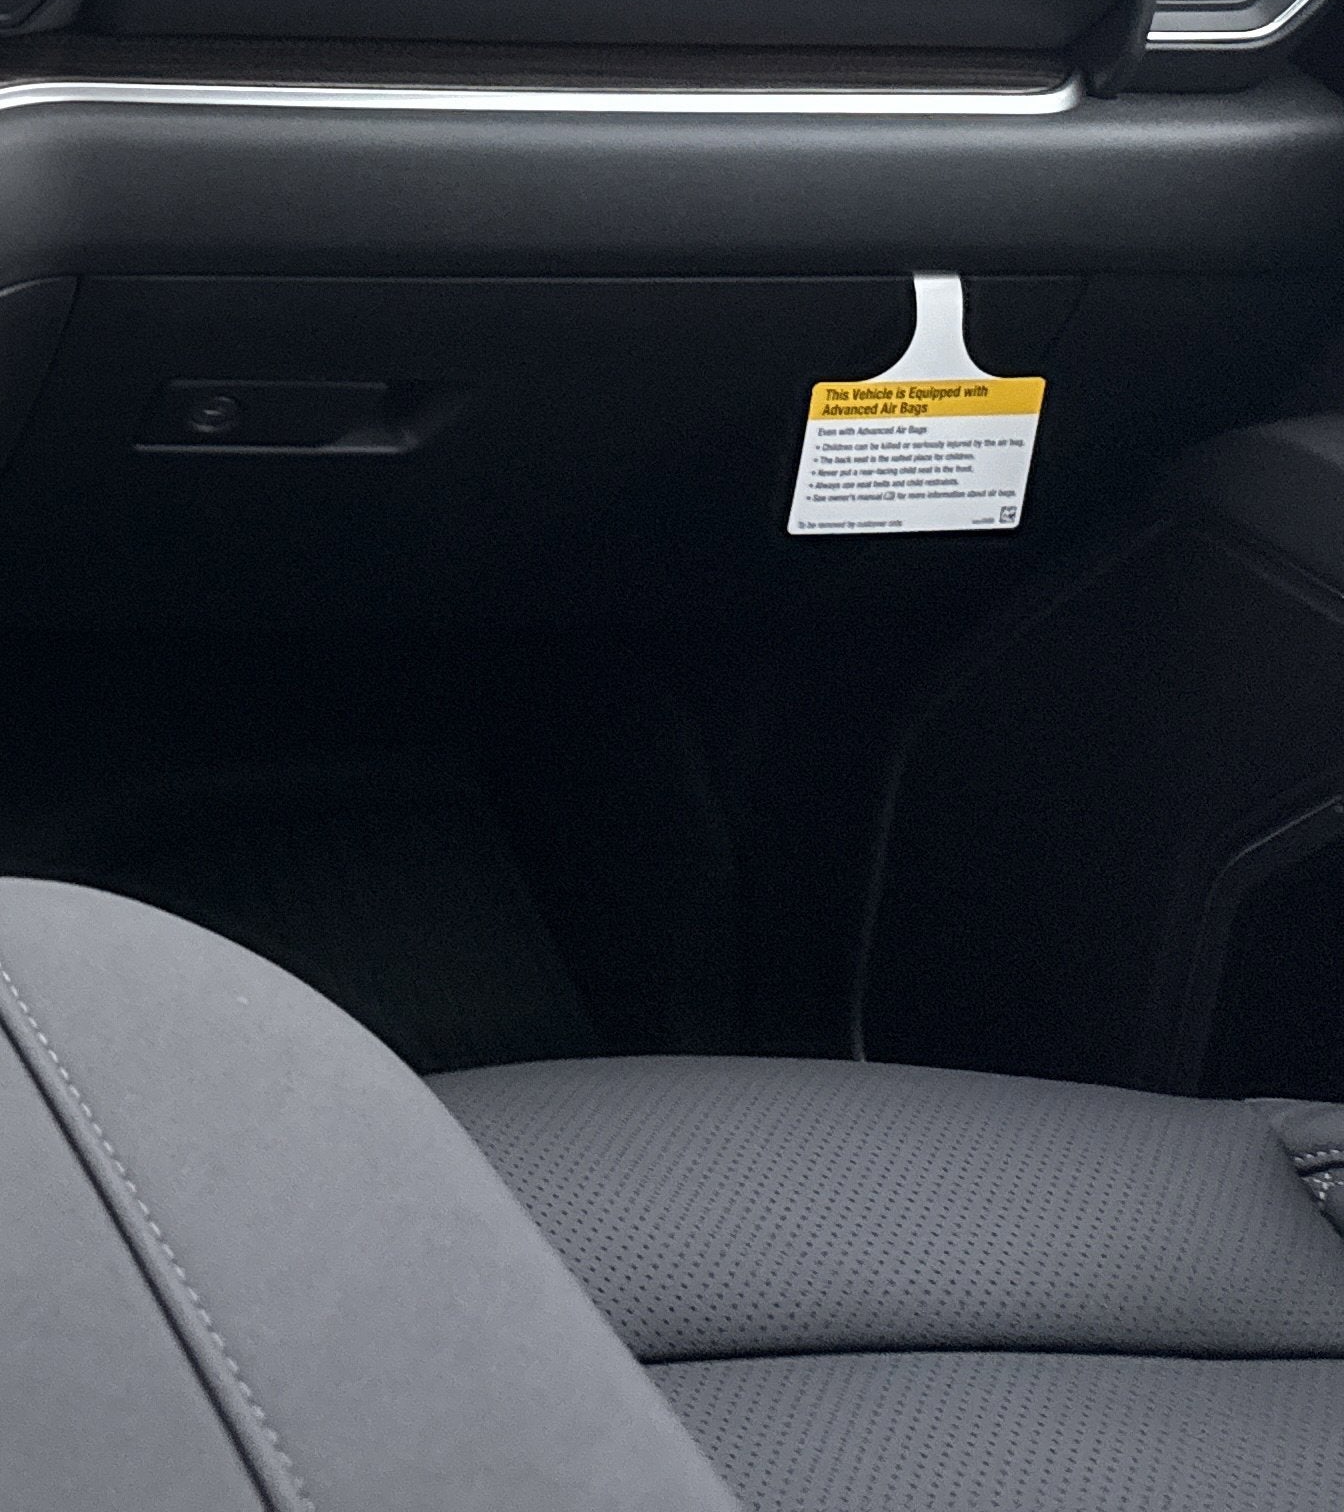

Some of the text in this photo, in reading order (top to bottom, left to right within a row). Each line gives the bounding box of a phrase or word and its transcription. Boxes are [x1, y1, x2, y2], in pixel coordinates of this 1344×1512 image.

[826, 385, 988, 401] This Vehicle is Equipped with
[822, 402, 928, 416] Advanced Air Bags
